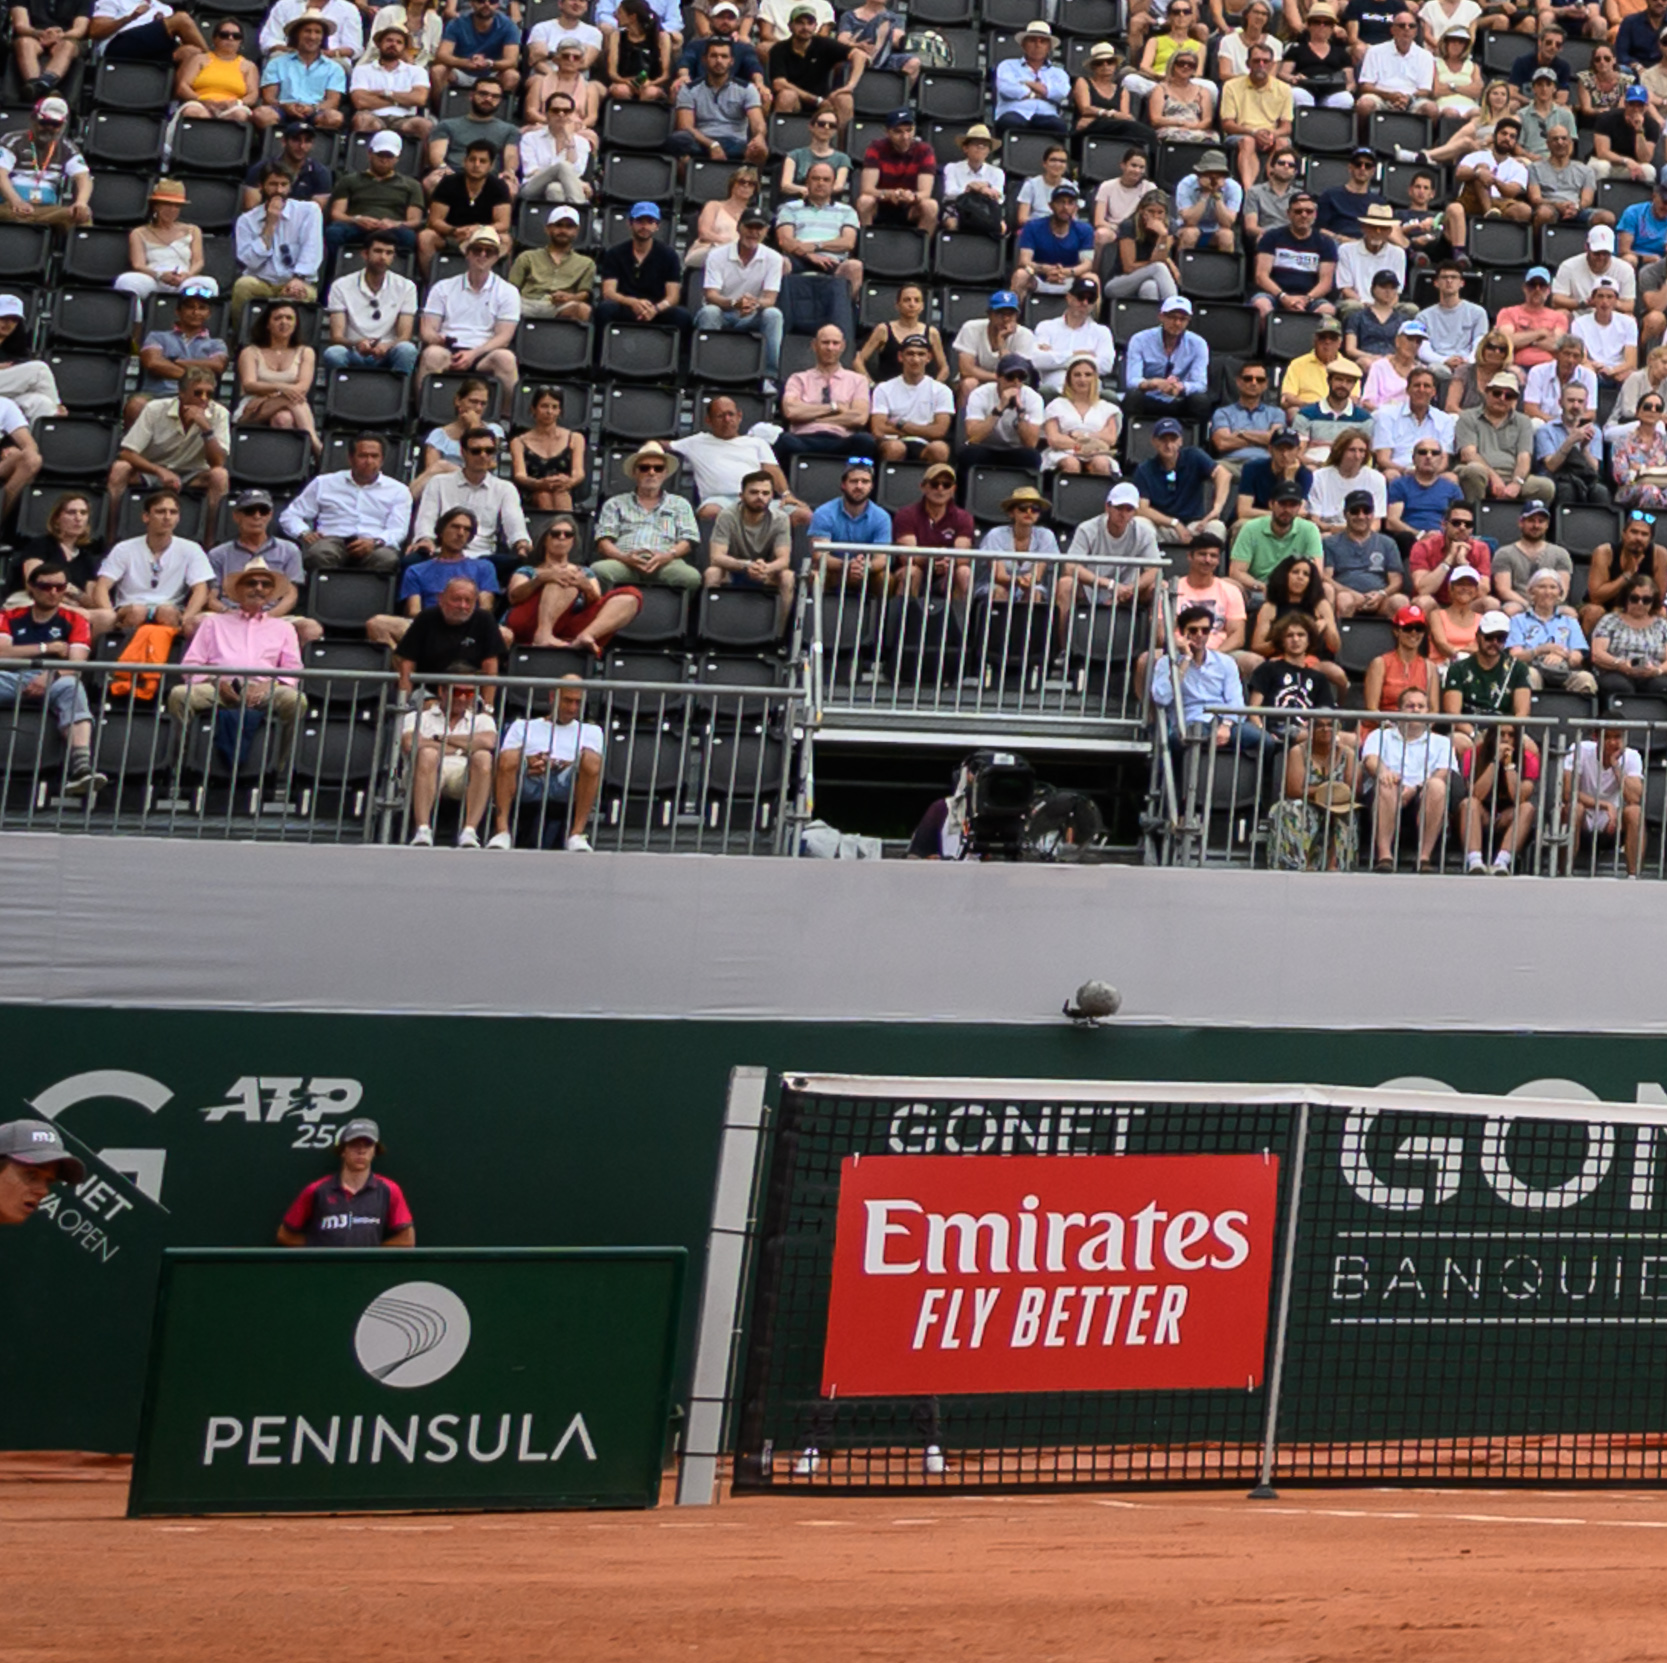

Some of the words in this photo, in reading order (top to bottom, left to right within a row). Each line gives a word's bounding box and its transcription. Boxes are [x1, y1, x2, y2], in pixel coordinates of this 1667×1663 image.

[200, 1076, 364, 1122] ATP
[291, 1124, 346, 1149] 25
[888, 1102, 1147, 1157] GONET
[863, 1194, 1250, 1276] Emirates
[912, 1287, 1001, 1350] FLY
[1010, 1284, 1189, 1348] BETTER
[202, 1412, 598, 1466] PENINSULA
